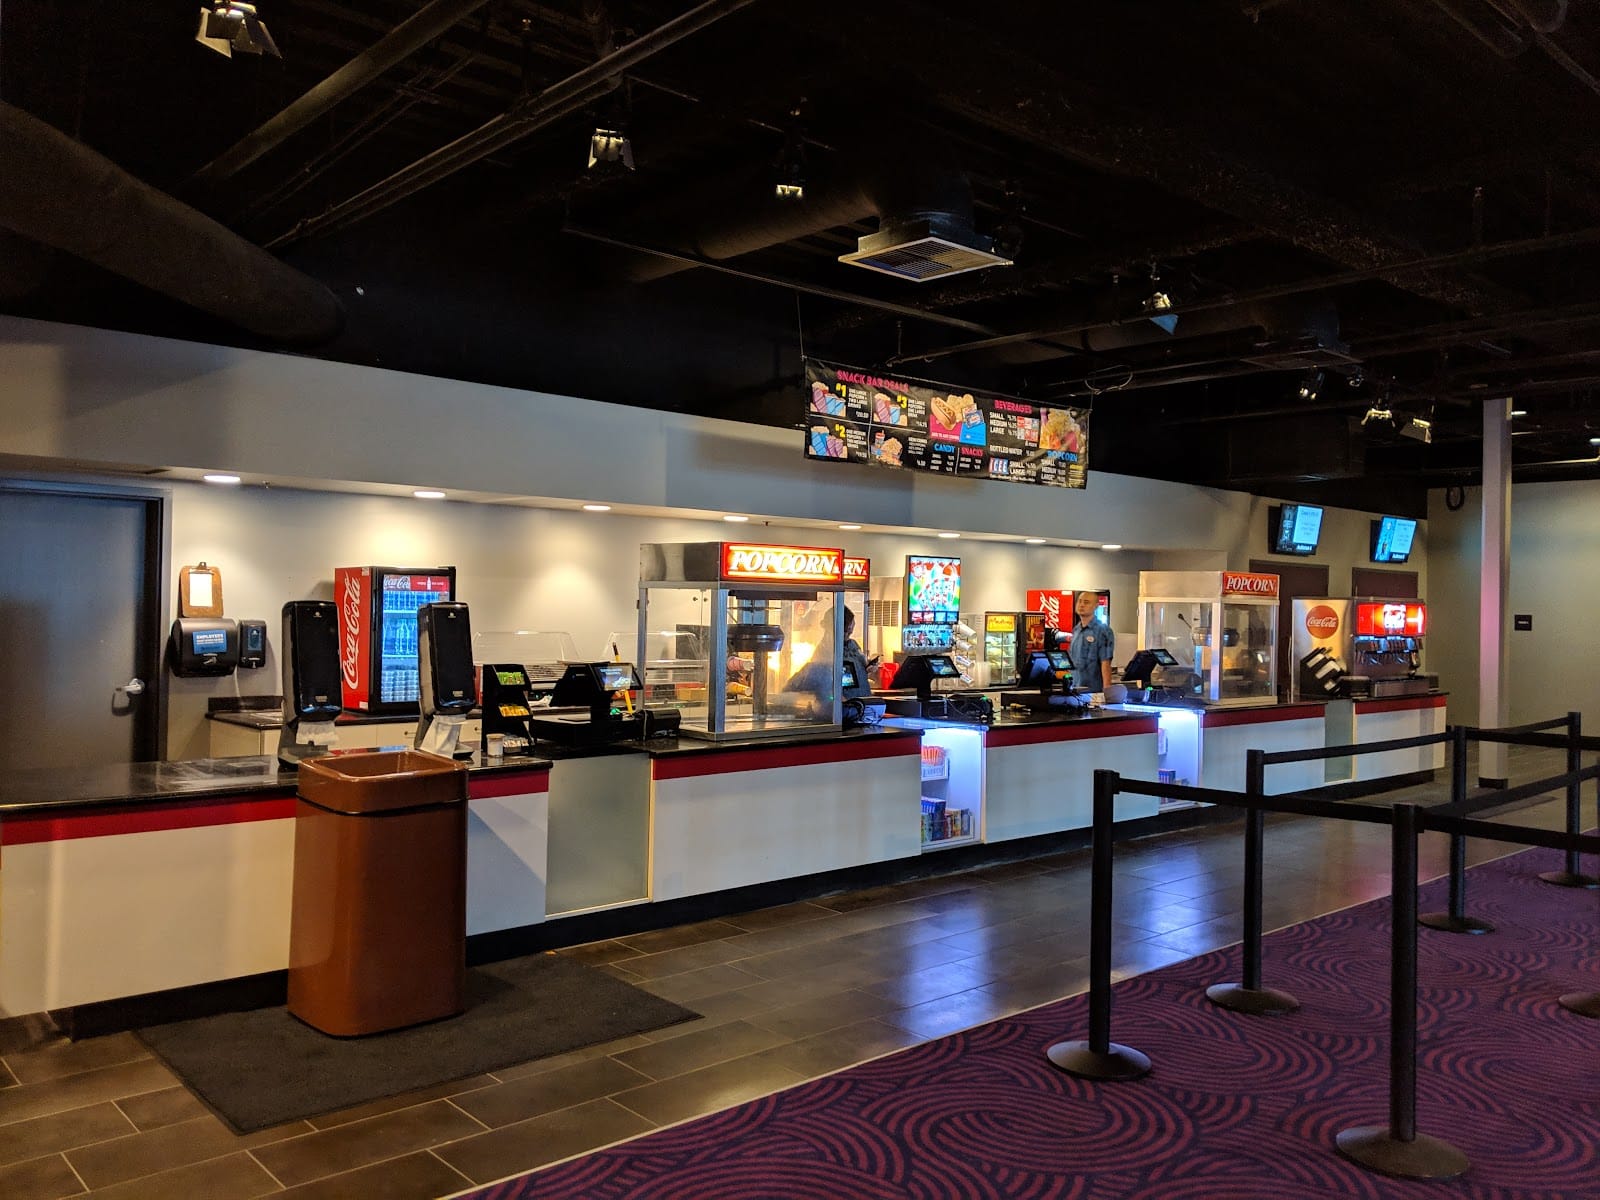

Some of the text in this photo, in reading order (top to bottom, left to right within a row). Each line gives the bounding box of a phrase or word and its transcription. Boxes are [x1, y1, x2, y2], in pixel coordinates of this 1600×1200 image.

[837, 369, 865, 385] SNACK
[866, 375, 883, 388] BAR
[994, 399, 1033, 414] BEVERAGES
[989, 411, 1006, 420] SMALL
[990, 427, 1005, 435] LARGE
[934, 443, 956, 453] CANDY
[961, 447, 983, 456] SNACKS
[989, 444, 1008, 454] BOTTLED
[1047, 450, 1078, 462] POPCORN
[989, 457, 1009, 474] ICEE
[1009, 460, 1025, 468] SMALL
[1009, 468, 1026, 476] LARGE
[729, 550, 837, 574] POPCORN
[1225, 574, 1275, 593] POPCORN
[1307, 616, 1337, 628] Coca-Cola
[343, 571, 361, 690] Coca-Cola
